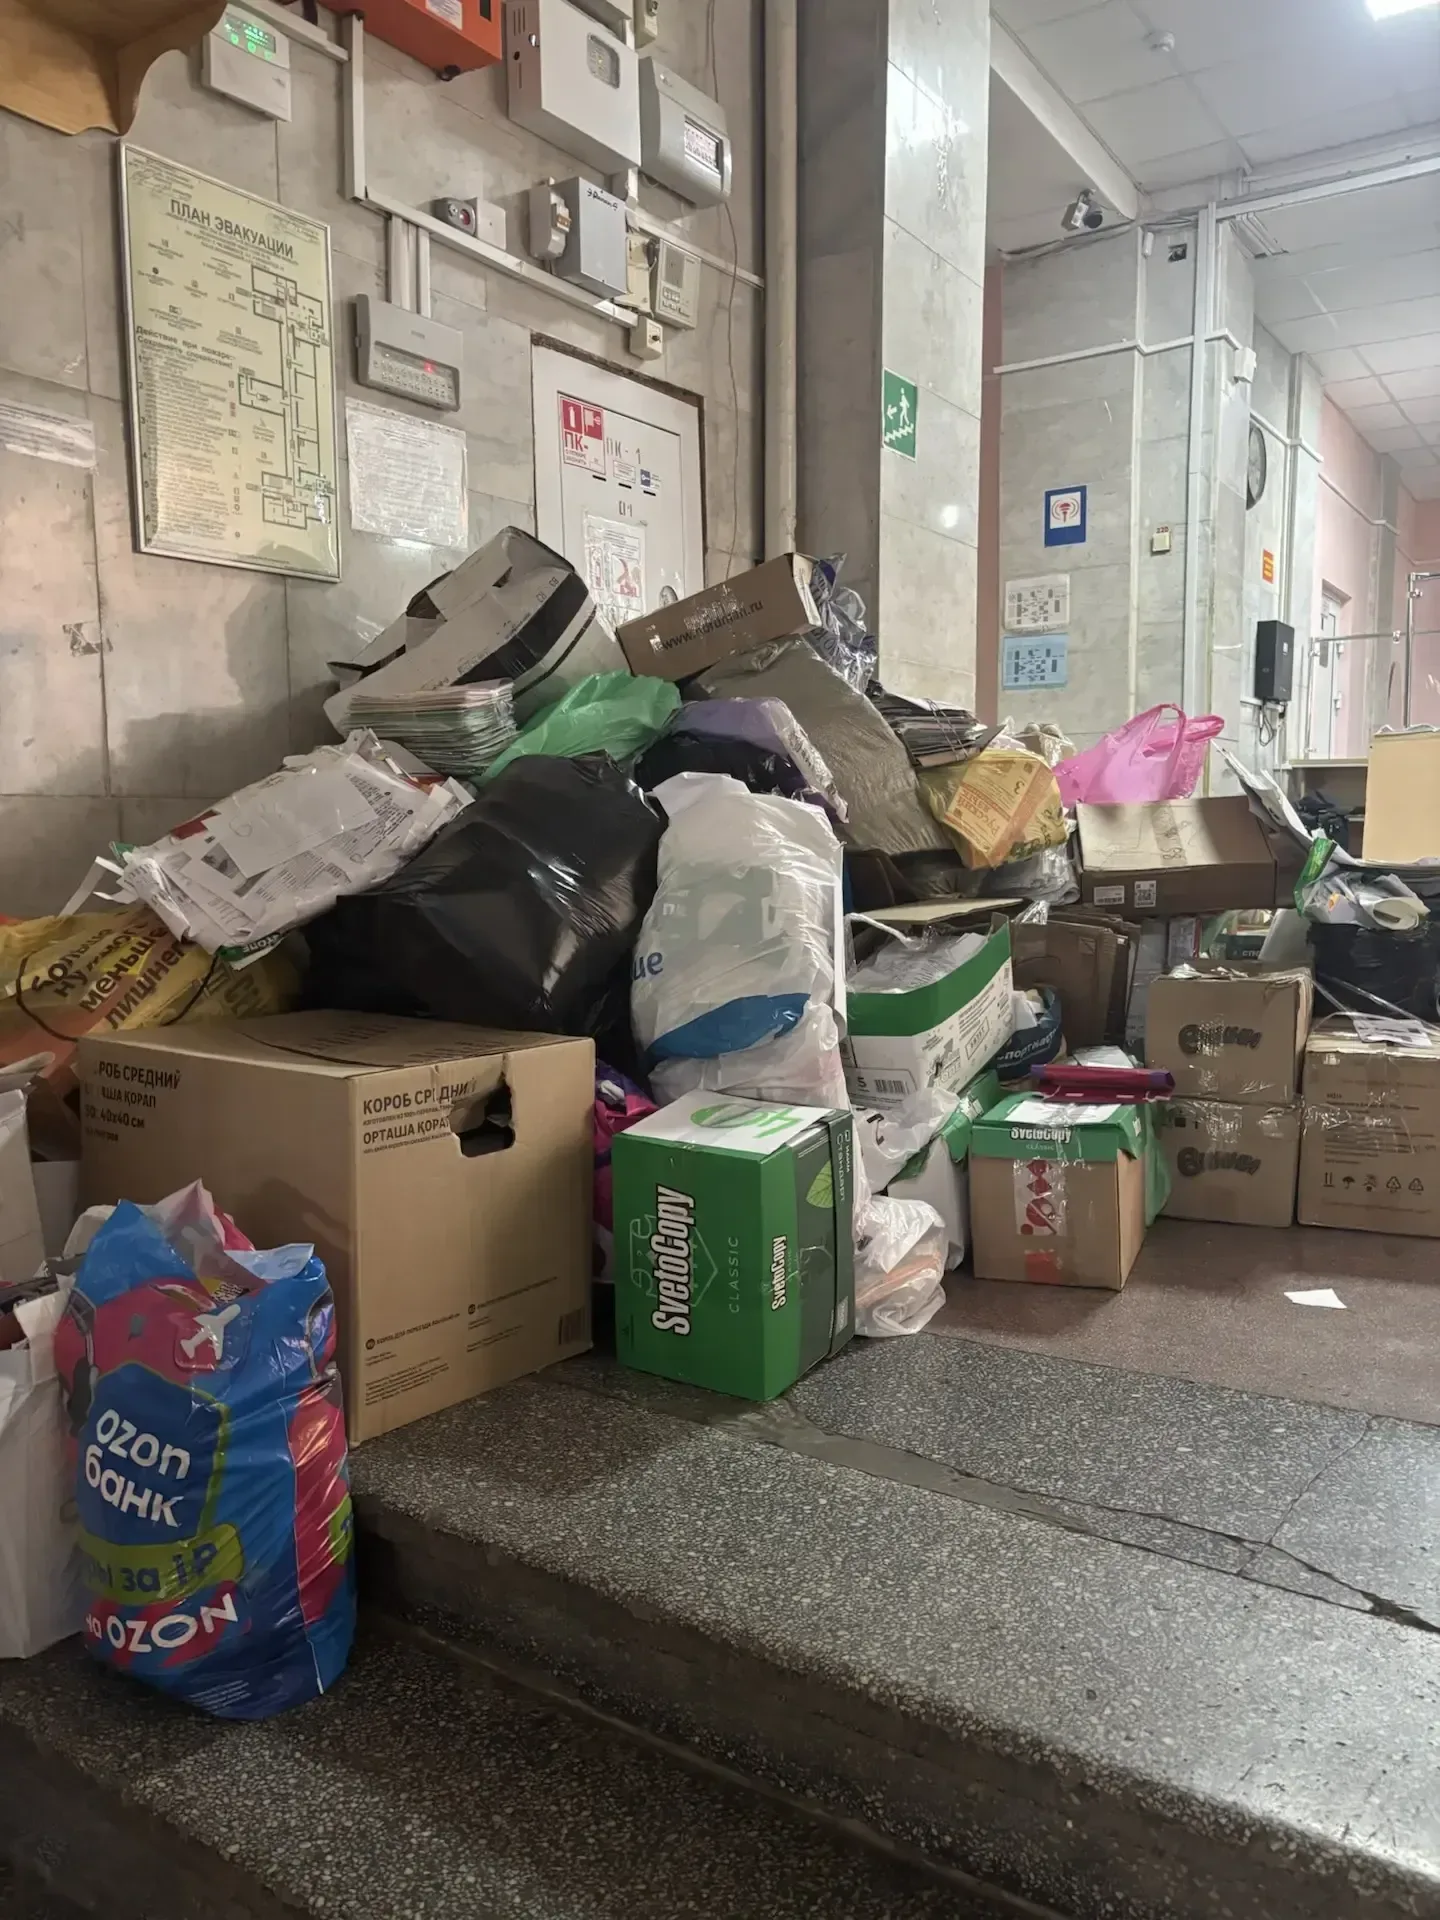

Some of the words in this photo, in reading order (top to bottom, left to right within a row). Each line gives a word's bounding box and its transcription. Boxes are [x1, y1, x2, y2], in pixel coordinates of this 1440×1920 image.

[170, 199, 211, 227] ПЛАН
[214, 216, 294, 259] ЭВАКУАЦИИ
[136, 325, 178, 345] Действие
[182, 339, 198, 351] при
[564, 431, 588, 453] ПК-
[122, 1064, 183, 1090] СРЕДНИЙ
[363, 1093, 412, 1116] КОРОБ
[362, 1123, 415, 1146] ОРТАША
[1010, 1126, 1072, 1144] SvetoCopy
[651, 1183, 696, 1337] SvetoCopy
[727, 1235, 740, 1315] CLASSIC
[770, 1234, 788, 1312] SvetoCopy
[96, 1408, 191, 1480] ozon
[84, 1444, 185, 1529] банк
[120, 1567, 162, 1593] за
[106, 1592, 240, 1655] OZON
